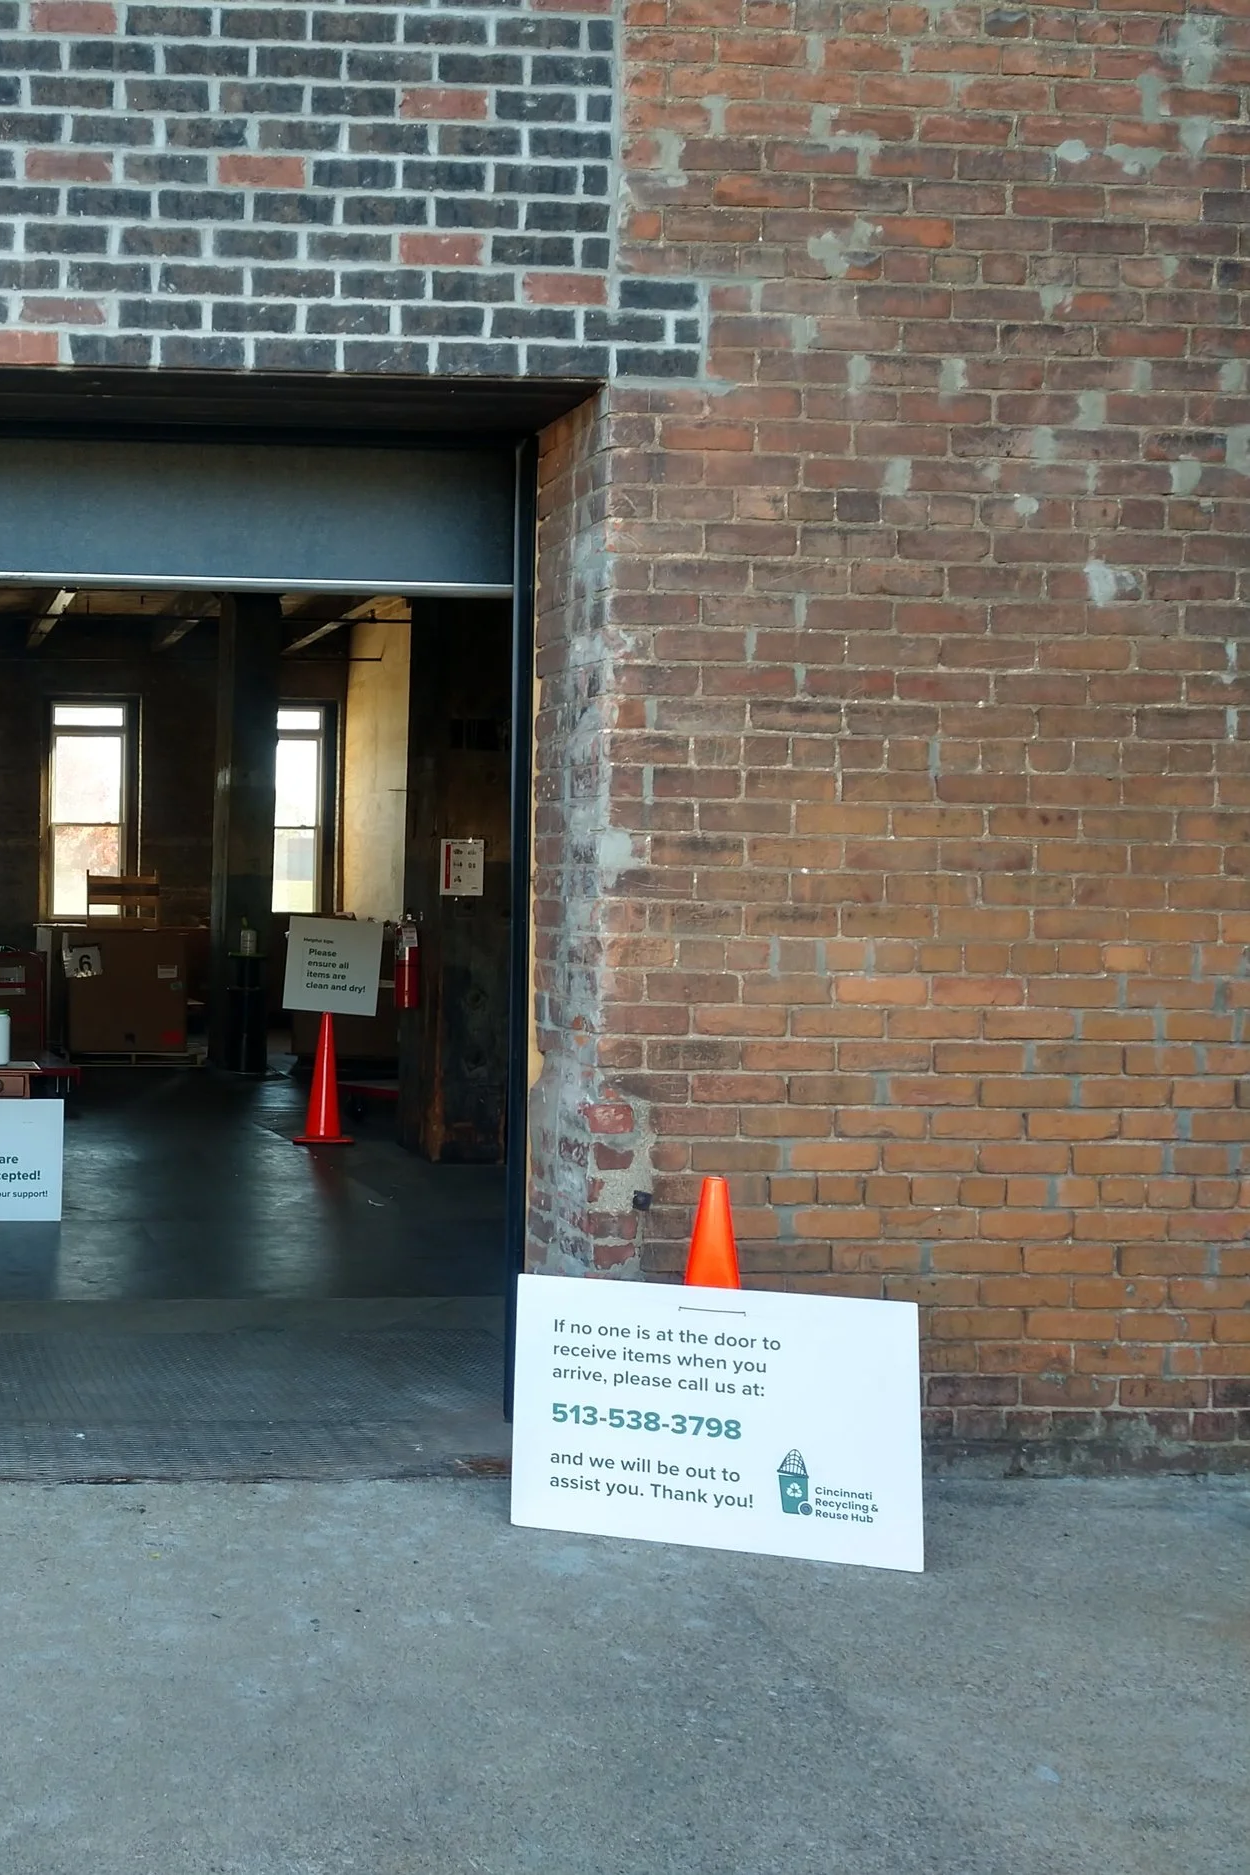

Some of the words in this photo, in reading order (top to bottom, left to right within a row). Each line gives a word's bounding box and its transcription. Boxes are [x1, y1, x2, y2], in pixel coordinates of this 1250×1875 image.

[309, 948, 336, 957] Please
[308, 960, 336, 968] ensure
[307, 970, 330, 979] items
[332, 972, 346, 980] are
[331, 984, 346, 992] and
[349, 984, 366, 994] dry!
[0, 1156, 19, 1164] are
[13, 1190, 47, 1199] support!
[555, 1319, 565, 1332] If
[571, 1324, 592, 1334] no
[598, 1326, 630, 1338] one
[637, 1325, 650, 1339] is
[657, 1329, 673, 1341] at
[679, 1330, 708, 1344] the
[715, 1333, 757, 1348] door
[763, 1337, 780, 1350] to
[554, 1344, 616, 1359] receive
[623, 1347, 671, 1364] items
[677, 1354, 726, 1369] when
[733, 1361, 766, 1374] you
[553, 1366, 607, 1384] arrive,
[614, 1371, 671, 1388] please
[678, 1378, 708, 1391] call
[716, 1382, 735, 1394] us
[742, 1384, 764, 1396] at:
[552, 1403, 741, 1439] 513-538-3798
[551, 1453, 582, 1465] and
[589, 1457, 614, 1469] we
[621, 1458, 650, 1472] will
[658, 1461, 679, 1475] be
[686, 1467, 716, 1480] out
[722, 1468, 740, 1482] to
[550, 1476, 600, 1491] assist
[606, 1483, 643, 1496] you.
[650, 1484, 707, 1503] Thank
[714, 1494, 753, 1508] you!
[815, 1487, 872, 1500] Cincinnati
[816, 1498, 868, 1513] Recycling
[871, 1504, 878, 1512] &
[816, 1509, 848, 1520] Reuse
[851, 1513, 873, 1523] Hub
